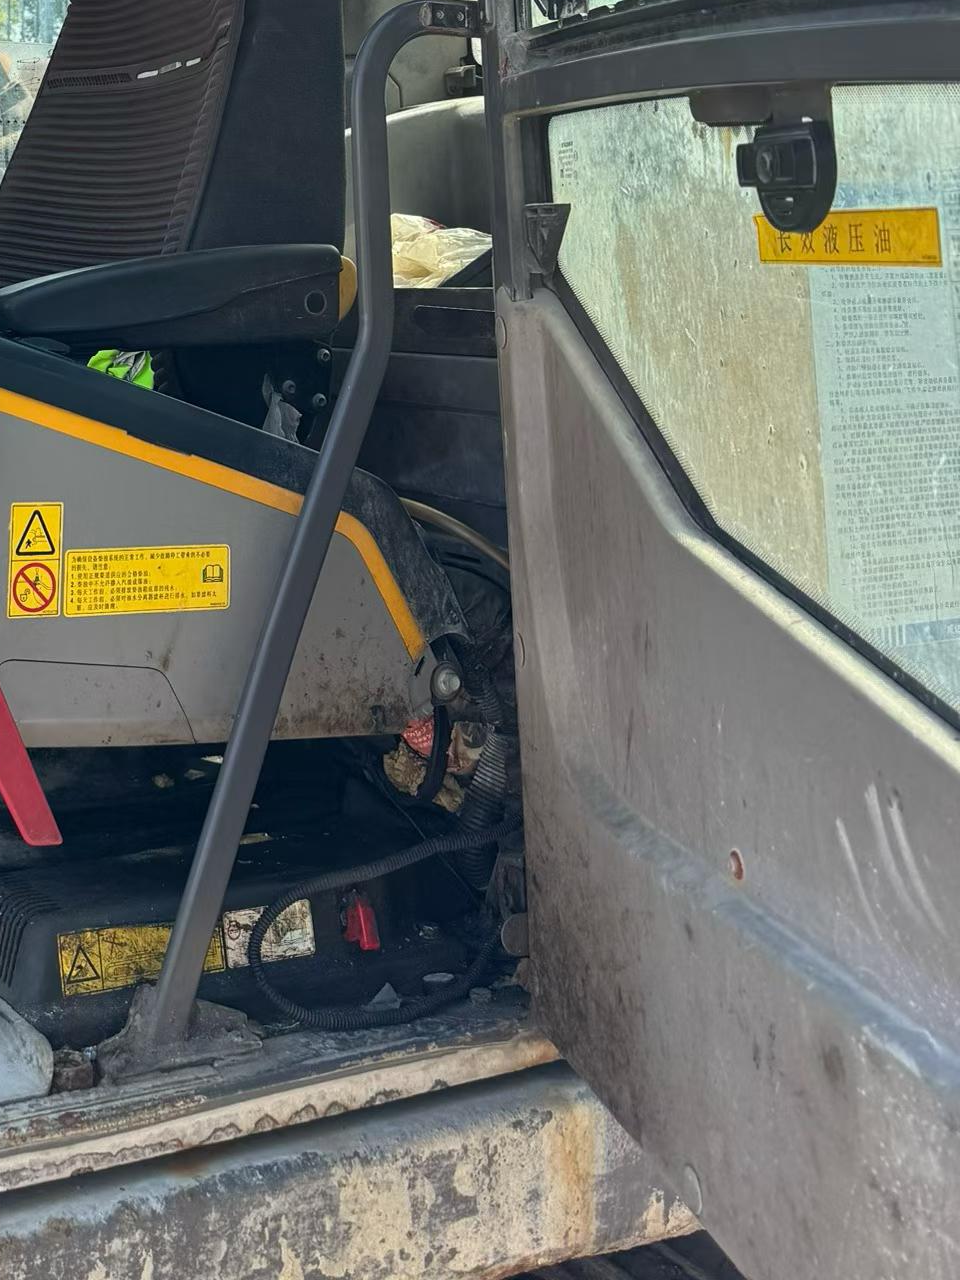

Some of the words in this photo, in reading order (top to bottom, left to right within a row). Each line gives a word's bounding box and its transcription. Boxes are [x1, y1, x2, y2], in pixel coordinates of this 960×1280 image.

[777, 223, 892, 254] 长效液压油
